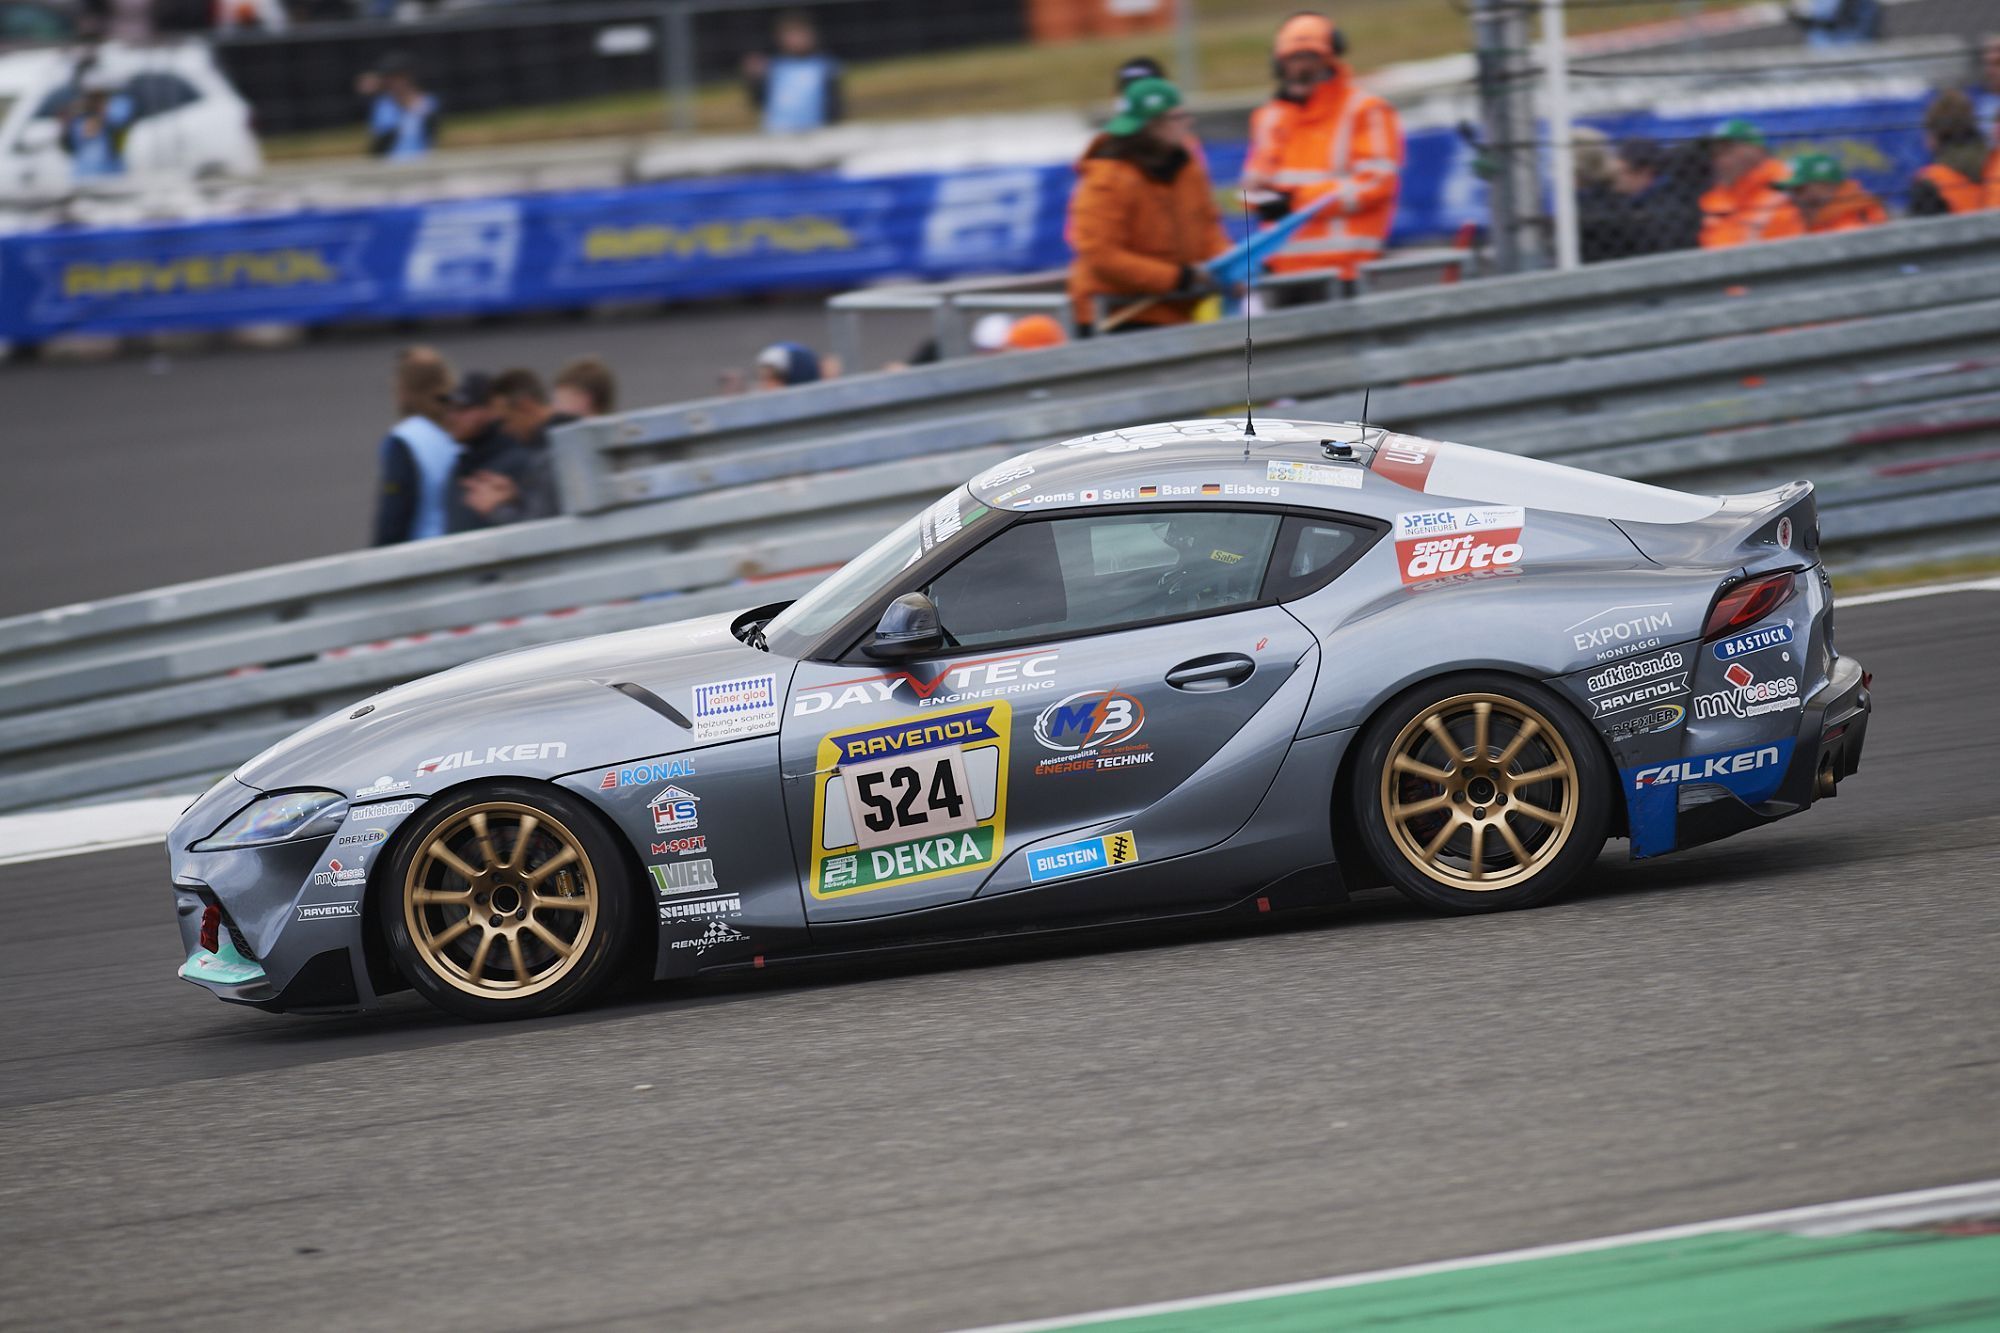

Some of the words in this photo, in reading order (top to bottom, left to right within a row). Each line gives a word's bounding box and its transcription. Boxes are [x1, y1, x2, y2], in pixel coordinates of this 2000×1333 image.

[1033, 492, 1075, 504] Ooms
[1103, 489, 1135, 500] Seki
[1162, 484, 1197, 496] Baar
[1413, 535, 1474, 556] sport
[1407, 543, 1524, 577] auto
[1573, 611, 1673, 652] EXPOTIM
[1725, 629, 1787, 656] BASTUCK
[1596, 637, 1660, 661] MONTAGGI
[1588, 653, 1682, 692] aufkleben.de
[709, 694, 740, 705] rainer
[919, 680, 1056, 707] ENGINEERING
[1600, 682, 1681, 711] RAVENOL
[698, 718, 733, 729] heizung
[1051, 700, 1133, 737] MB
[848, 720, 983, 758] RAVENOL
[415, 742, 566, 777] FALKEN
[1636, 747, 1778, 789] FALKEN
[621, 760, 695, 785] RONAL
[856, 760, 963, 834] 524
[353, 802, 414, 820] aufkleben.de
[653, 801, 696, 823] HS
[339, 833, 380, 845] DREXLER
[871, 834, 983, 880] DEKRA
[1037, 847, 1099, 872] BILSTEIN
[303, 905, 352, 916] RAVENOL
[660, 898, 741, 919] SCHROTH
[661, 912, 742, 926] RACING
